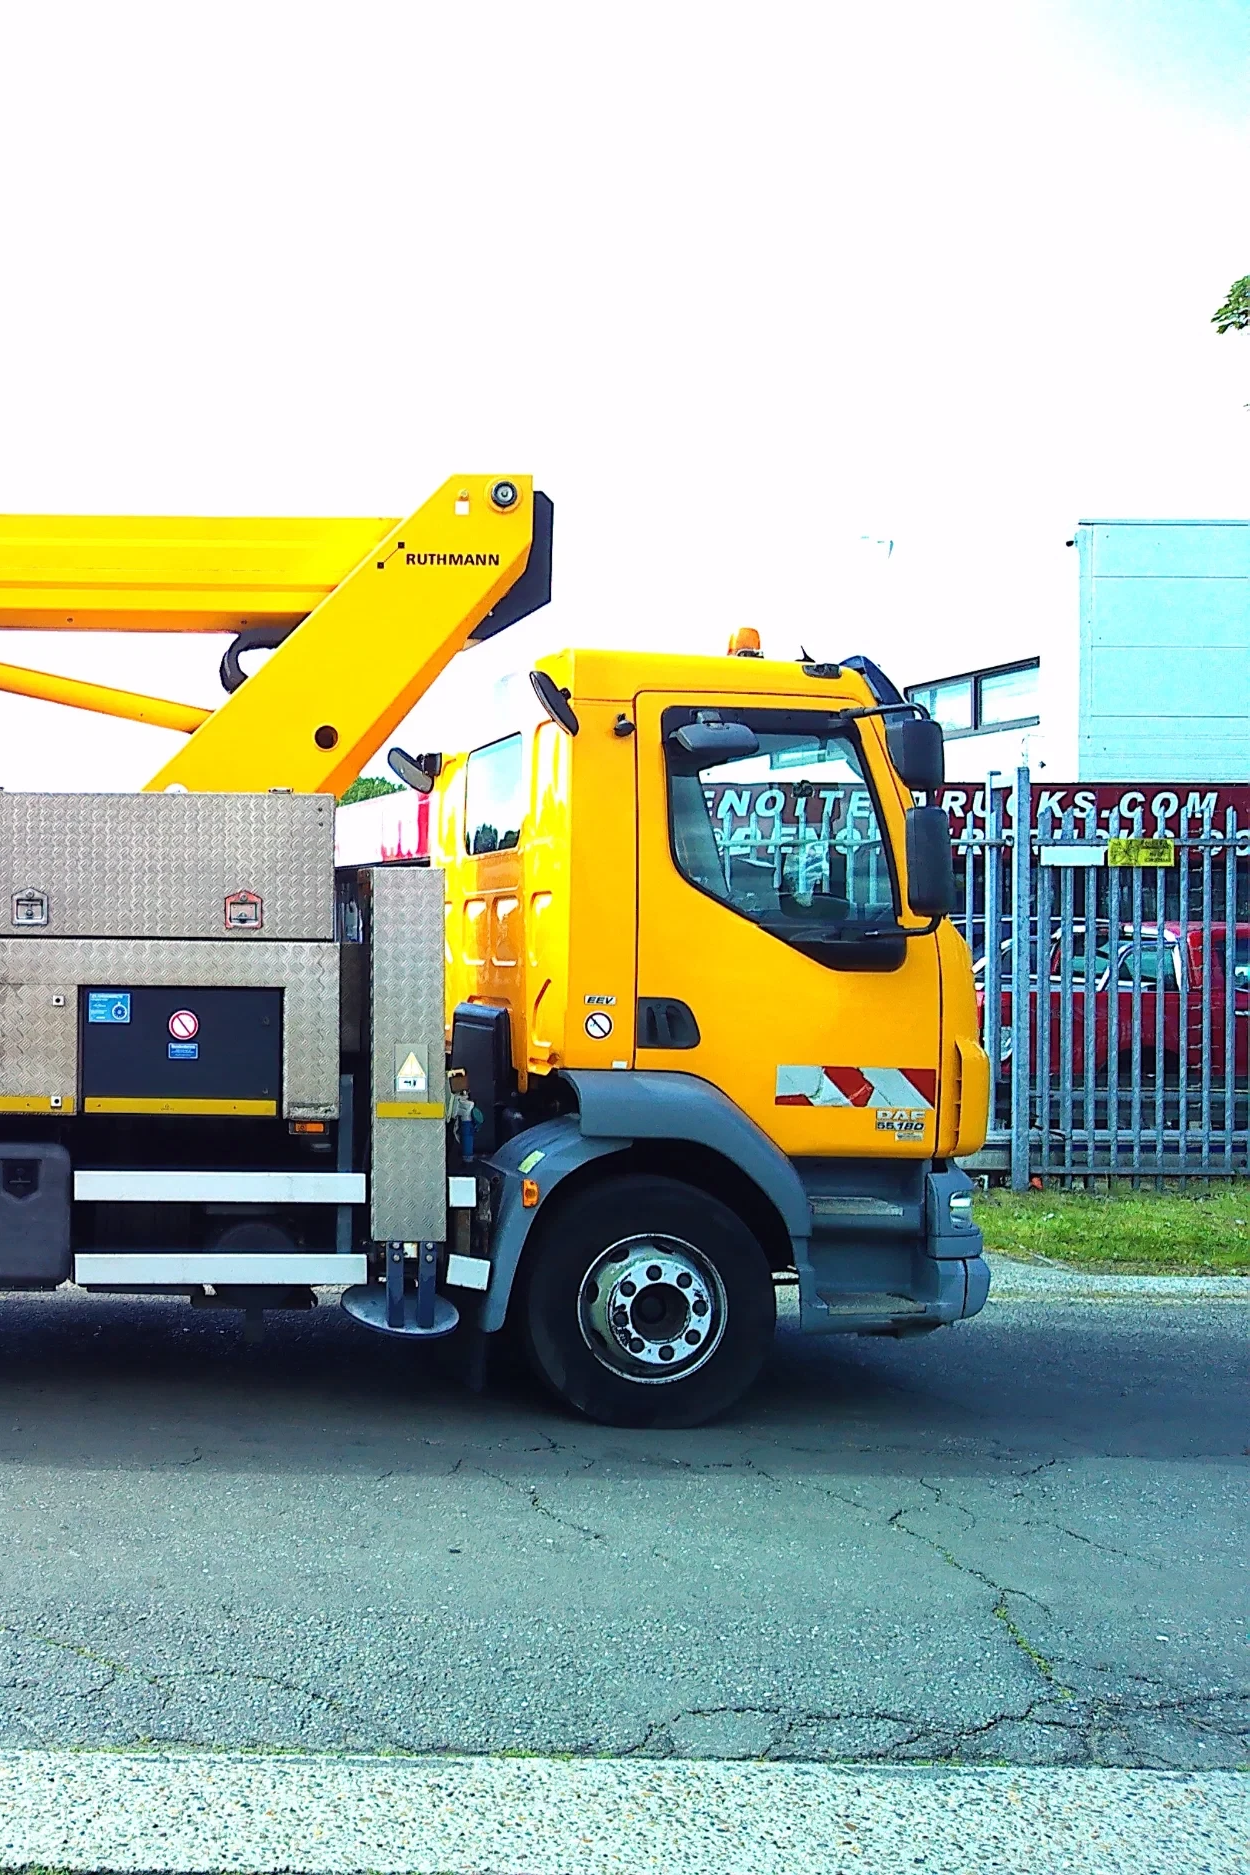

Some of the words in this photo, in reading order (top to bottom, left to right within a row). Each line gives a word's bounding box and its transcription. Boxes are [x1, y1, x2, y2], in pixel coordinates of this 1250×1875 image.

[405, 553, 500, 566] RUTHMANN
[586, 996, 614, 1005] EEV
[876, 1110, 926, 1120] DAF
